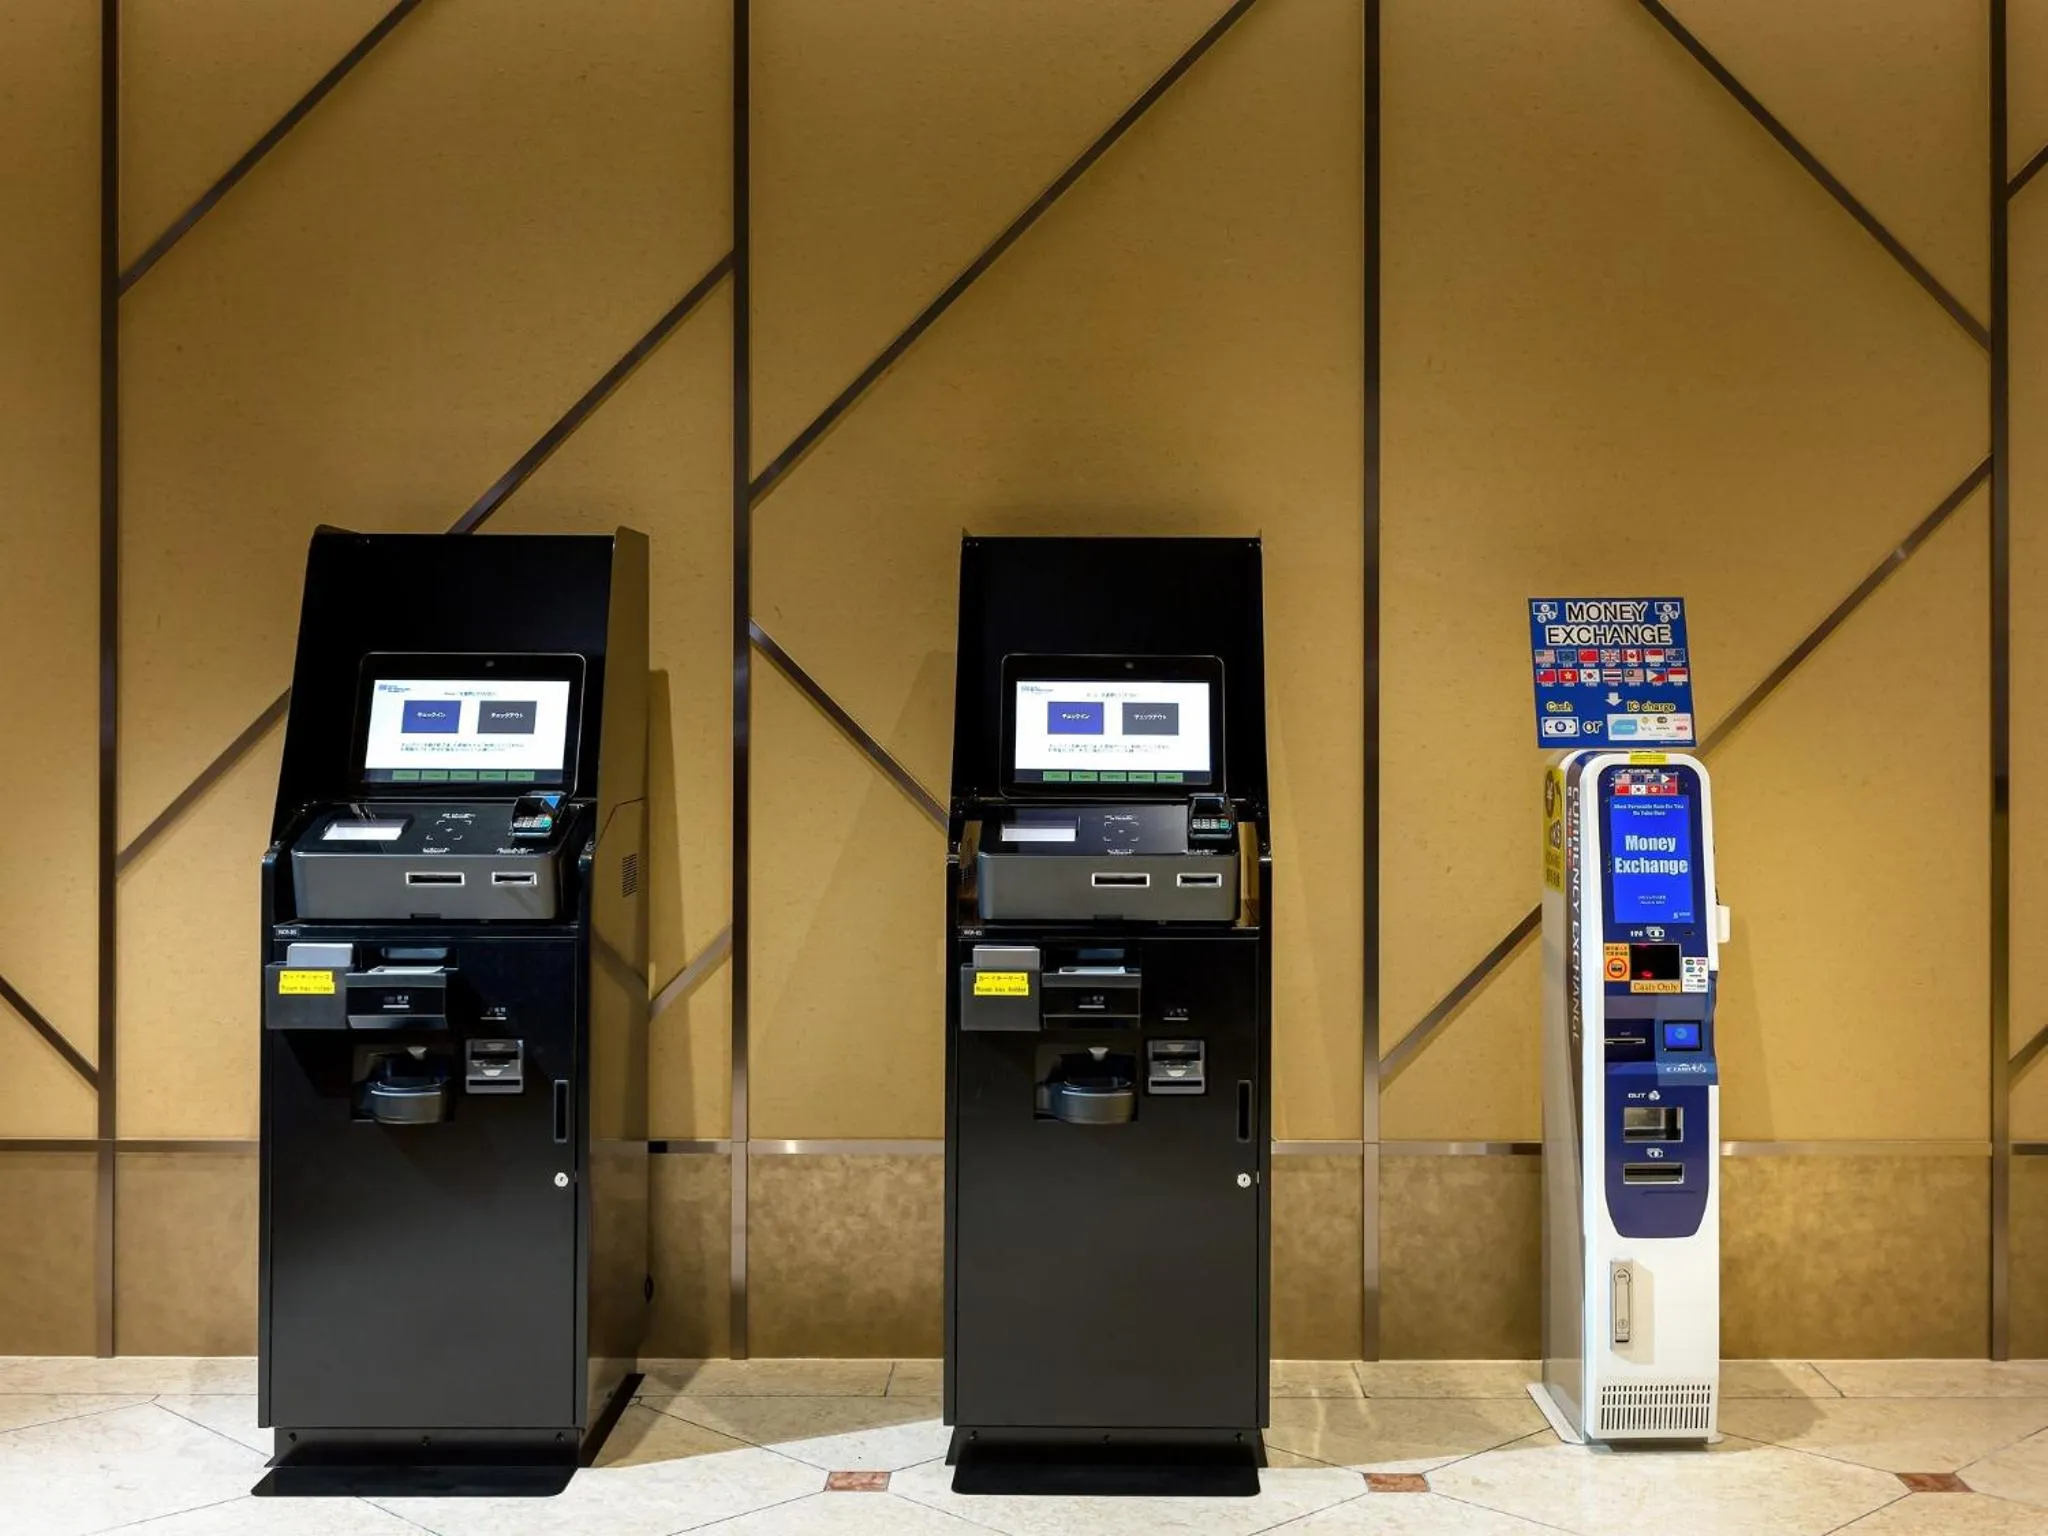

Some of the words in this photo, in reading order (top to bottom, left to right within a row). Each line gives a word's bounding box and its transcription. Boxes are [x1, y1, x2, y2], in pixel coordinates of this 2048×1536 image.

[1566, 601, 1648, 622] MONEY
[1546, 624, 1672, 645] EXCHANGE
[1547, 701, 1573, 712] Cash
[1627, 701, 1640, 712] IC
[1641, 702, 1676, 713] charge
[1583, 720, 1603, 733] or
[1572, 786, 1580, 912] CURRENCY
[1625, 835, 1676, 853] Money
[1614, 857, 1689, 876] Exchange
[1572, 921, 1582, 1041] EXCHANGE
[1633, 982, 1655, 992] Cash
[1657, 982, 1679, 993] Only
